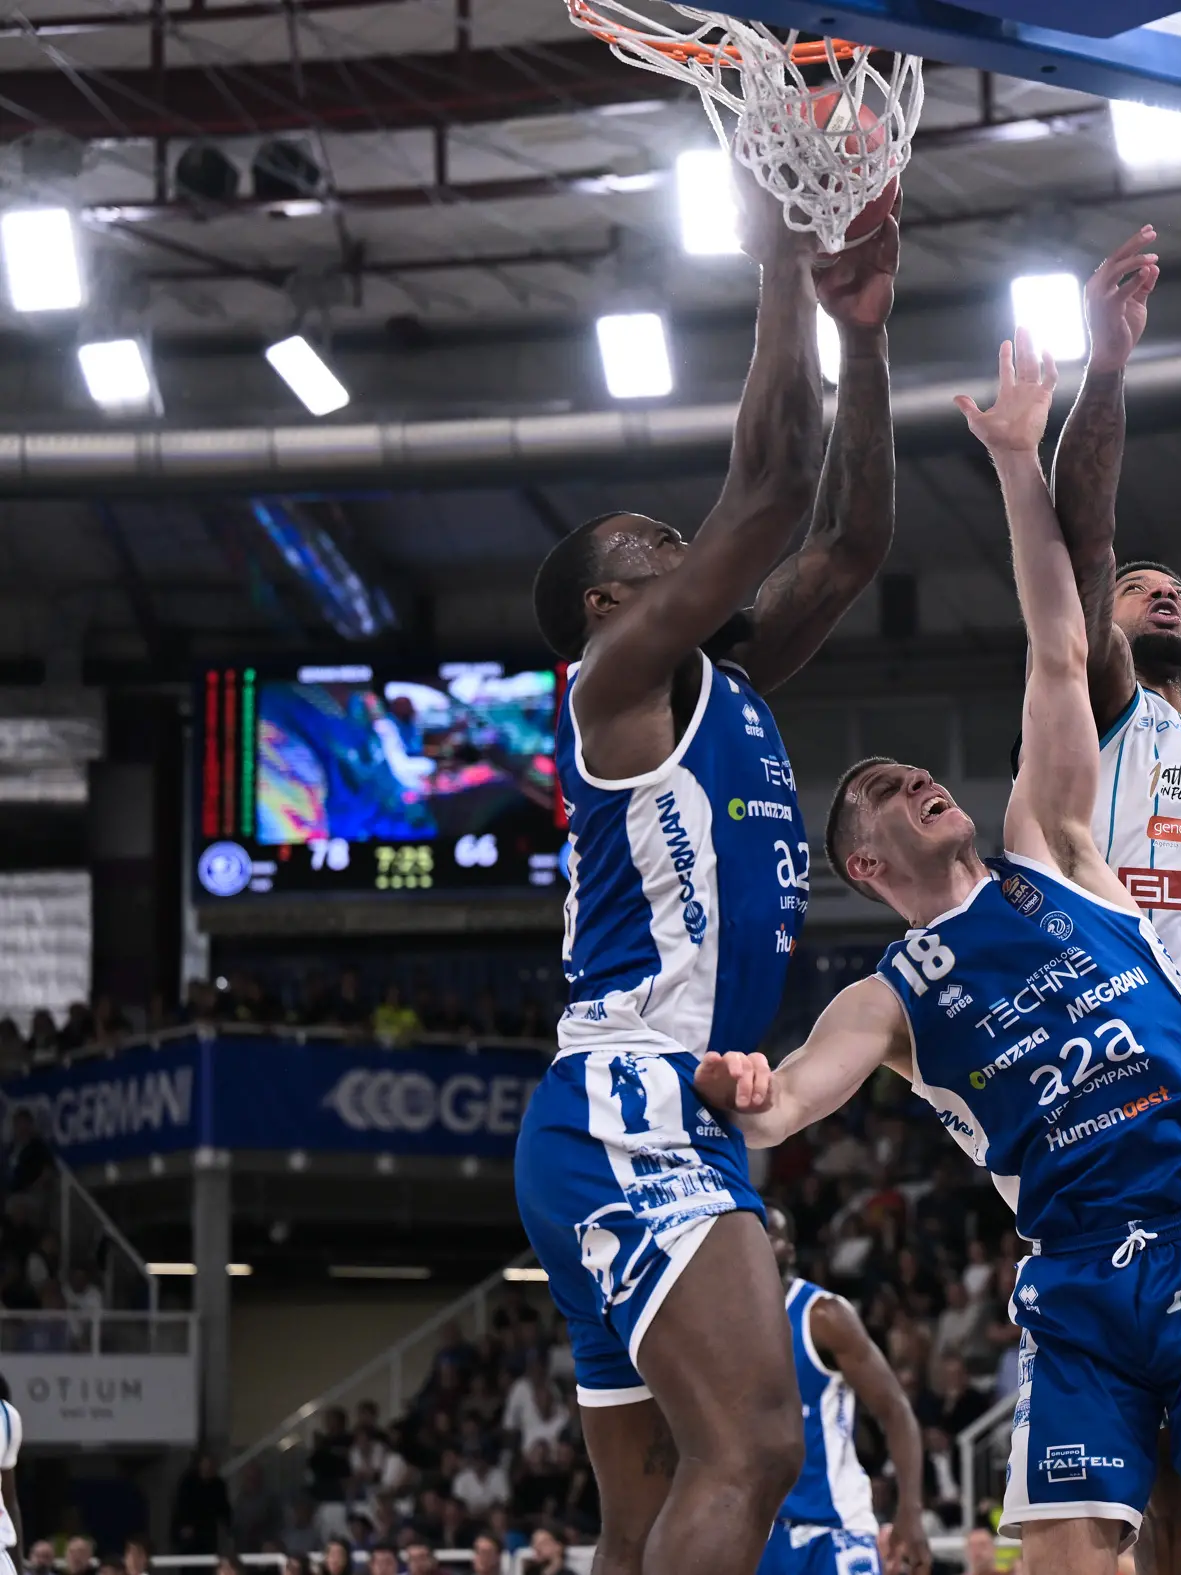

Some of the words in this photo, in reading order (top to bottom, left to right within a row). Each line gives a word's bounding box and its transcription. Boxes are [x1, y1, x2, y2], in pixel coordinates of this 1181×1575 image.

[891, 933, 956, 998] 18
[1065, 966, 1149, 1024] MEGRANI
[982, 1026, 1051, 1079] mazza
[1029, 1018, 1146, 1106] a2a
[1045, 1085, 1172, 1152] Humangest
[1050, 1449, 1080, 1457] GRUPPO
